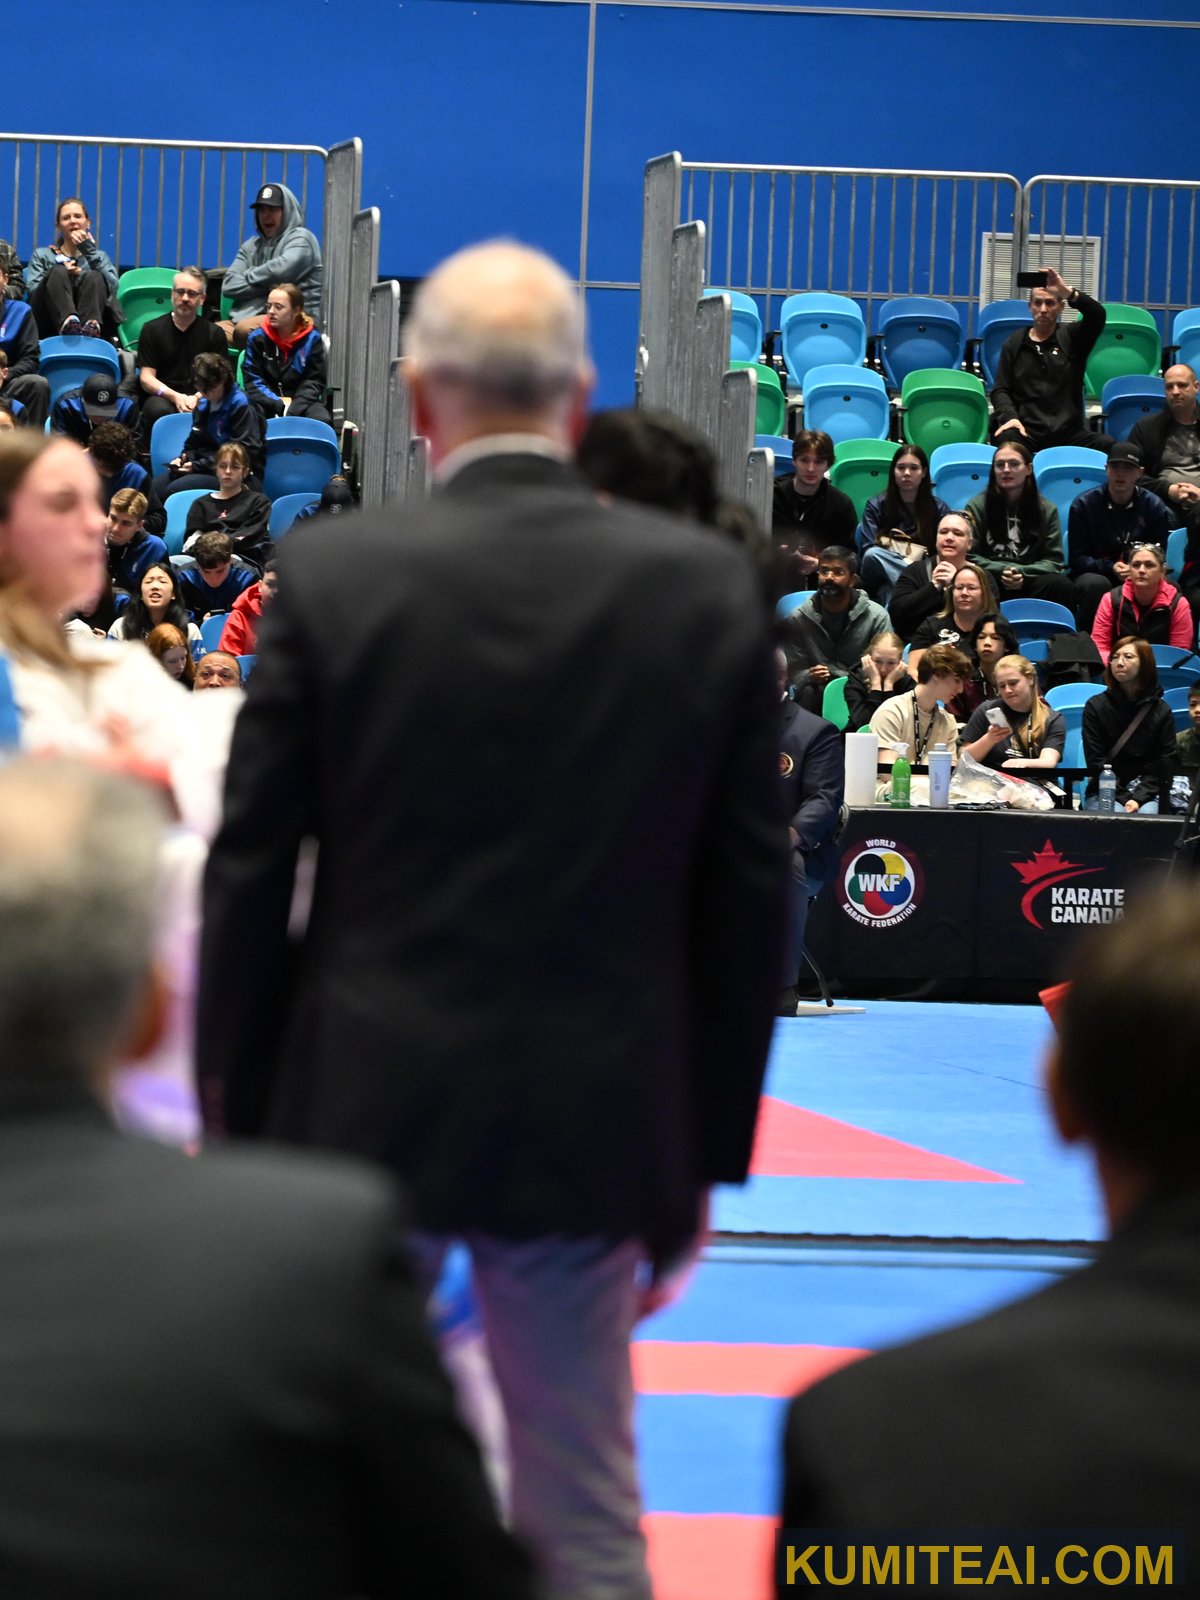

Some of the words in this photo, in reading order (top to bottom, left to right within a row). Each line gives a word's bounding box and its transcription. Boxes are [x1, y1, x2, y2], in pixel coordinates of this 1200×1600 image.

[865, 839, 896, 849] WORLD
[858, 874, 900, 892] WKF
[1051, 887, 1125, 906] KARATE
[842, 902, 869, 926] KARATE
[871, 903, 917, 928] FEDERATION
